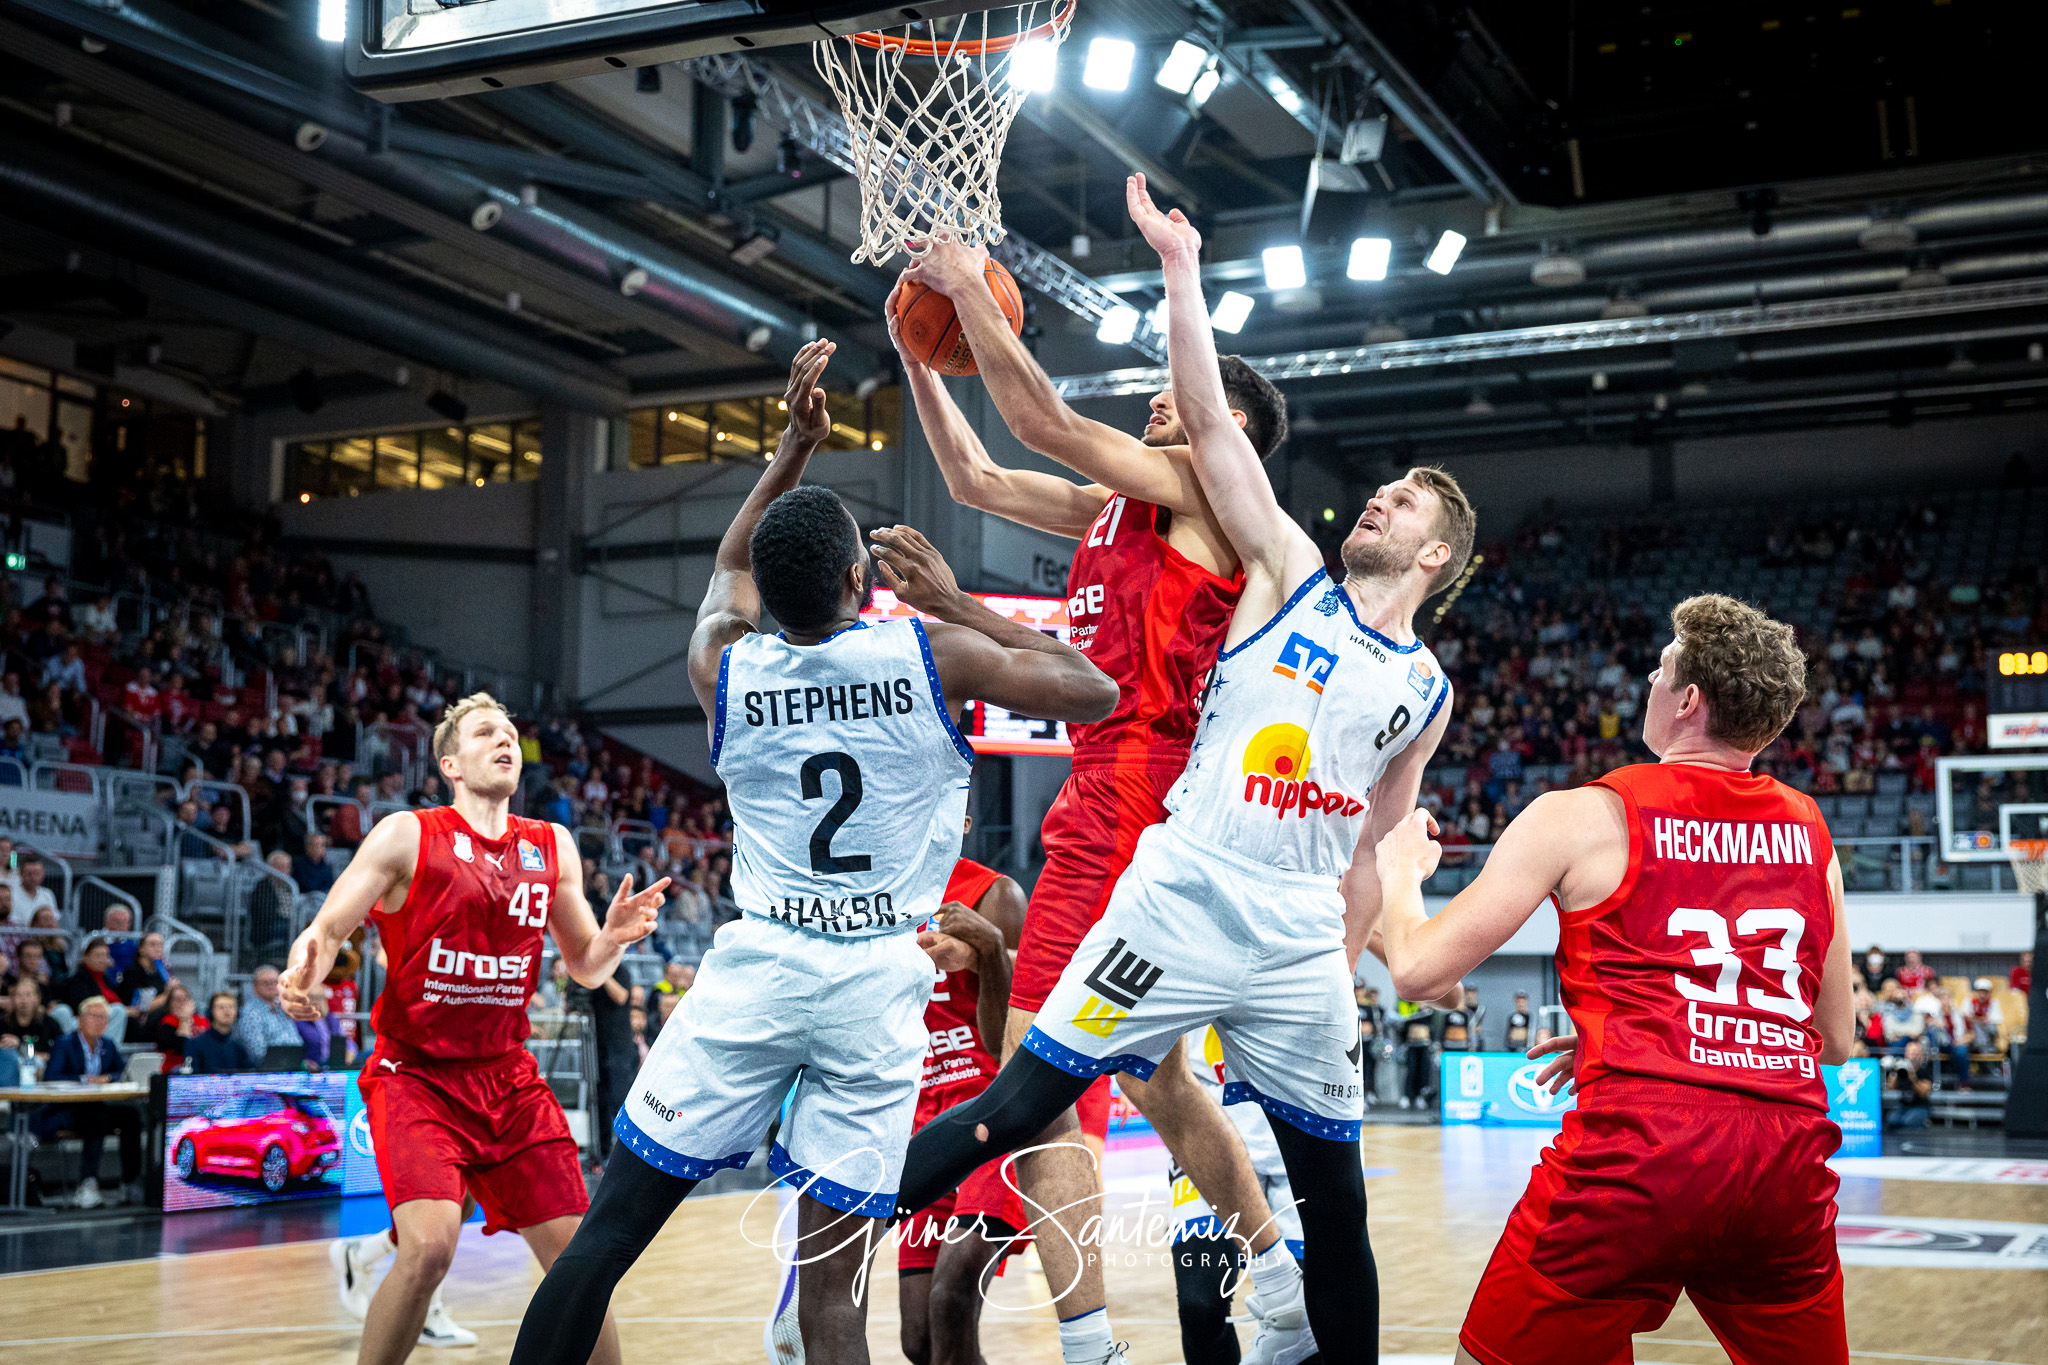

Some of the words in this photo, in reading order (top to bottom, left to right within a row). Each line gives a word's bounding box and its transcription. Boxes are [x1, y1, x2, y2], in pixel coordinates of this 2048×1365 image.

[1087, 496, 1127, 548] 21
[1350, 634, 1387, 664] HAKRO
[744, 678, 913, 727] STEPHENS
[1374, 704, 1411, 751] 9
[0, 807, 88, 839] ARENA
[800, 751, 872, 877] 2
[1654, 816, 1813, 865] HECKMANN
[508, 881, 550, 928] 43
[428, 937, 532, 980] brose
[1667, 907, 1812, 1023] 33
[422, 991, 442, 1003] der
[1688, 1000, 1807, 1052] brose
[1689, 1037, 1816, 1079] bamberg
[643, 1090, 676, 1122] HAKRO
[1323, 1083, 1344, 1098] DER
